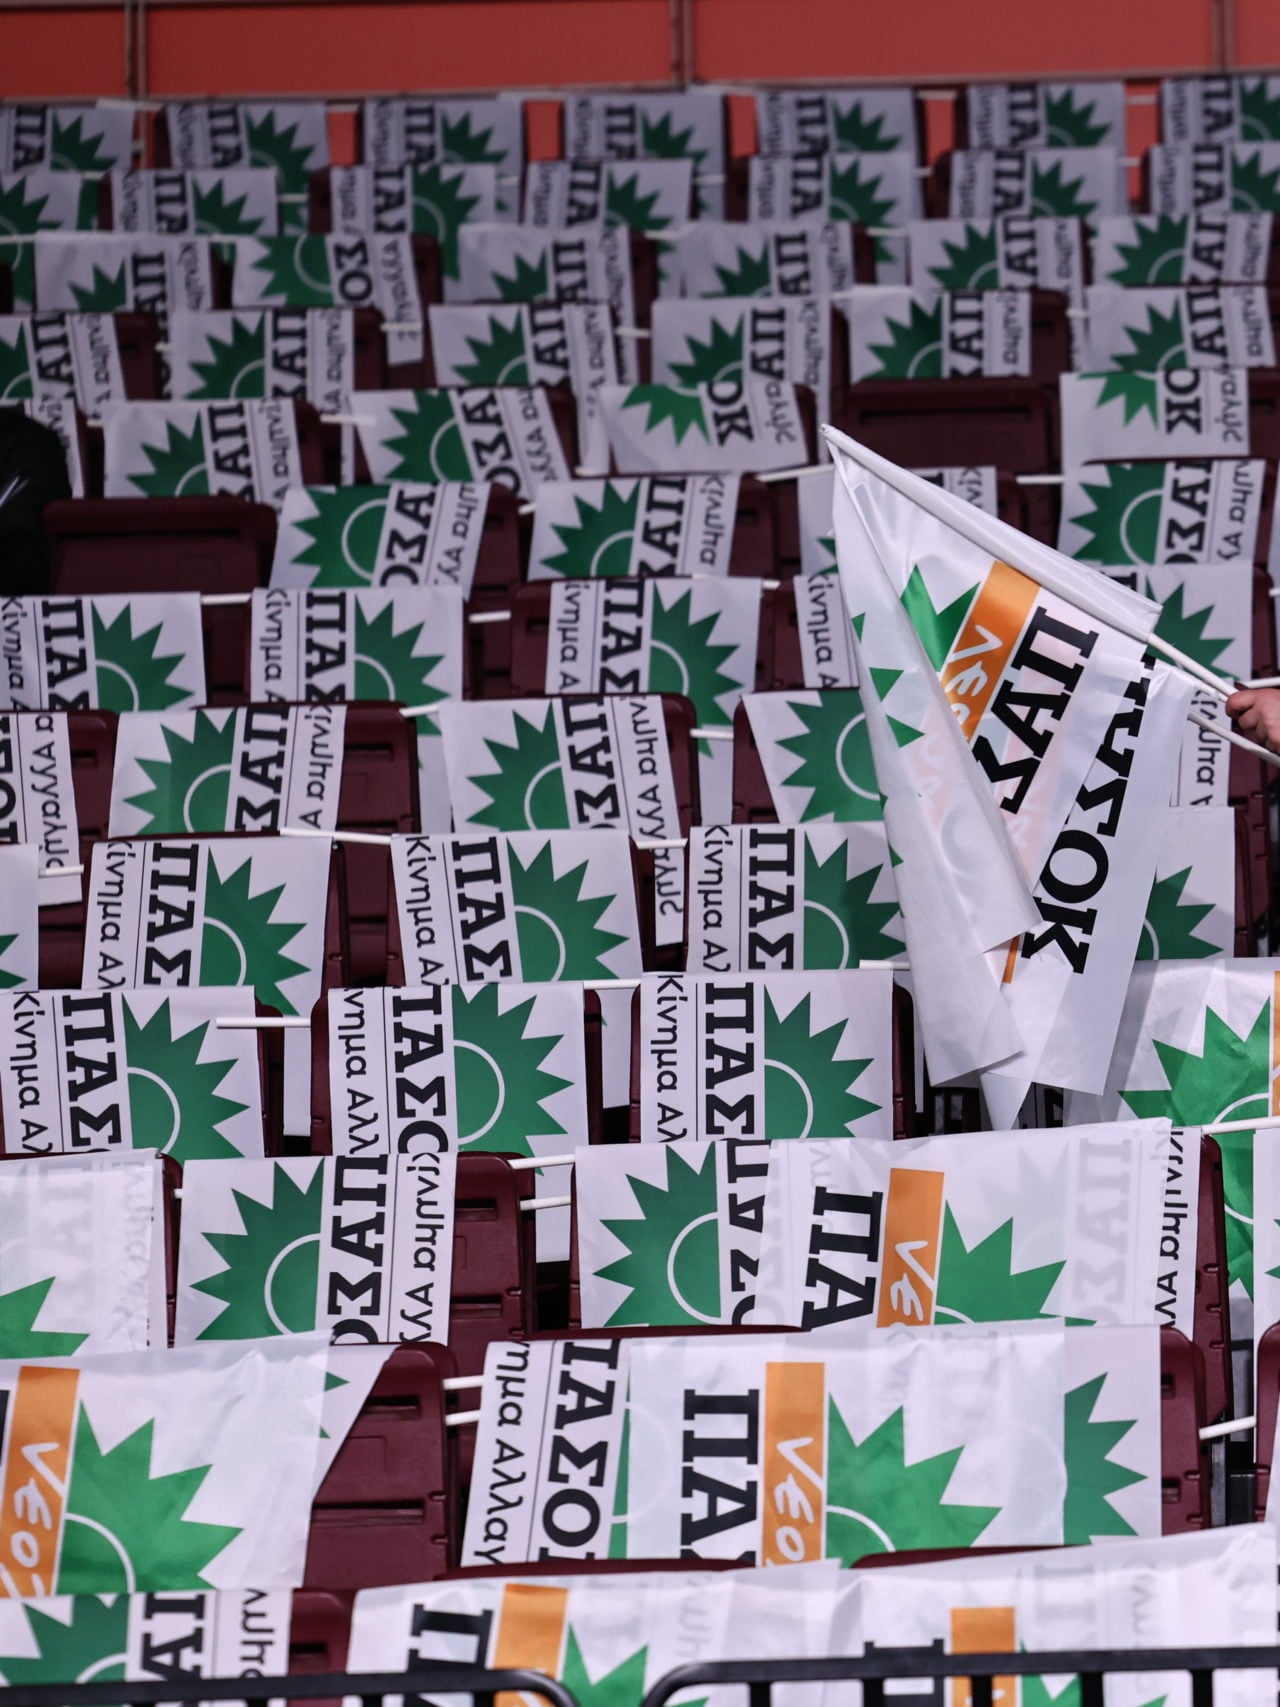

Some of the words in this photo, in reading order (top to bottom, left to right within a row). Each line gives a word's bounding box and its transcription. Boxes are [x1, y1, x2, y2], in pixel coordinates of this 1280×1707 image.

[748, 829, 795, 969] ΠΑΣ
[650, 975, 687, 1092] Κίνημα
[705, 983, 754, 1135] ΠΑΣ
[802, 1186, 884, 1331] ΠΑ
[680, 1390, 760, 1567] ΠΑ
